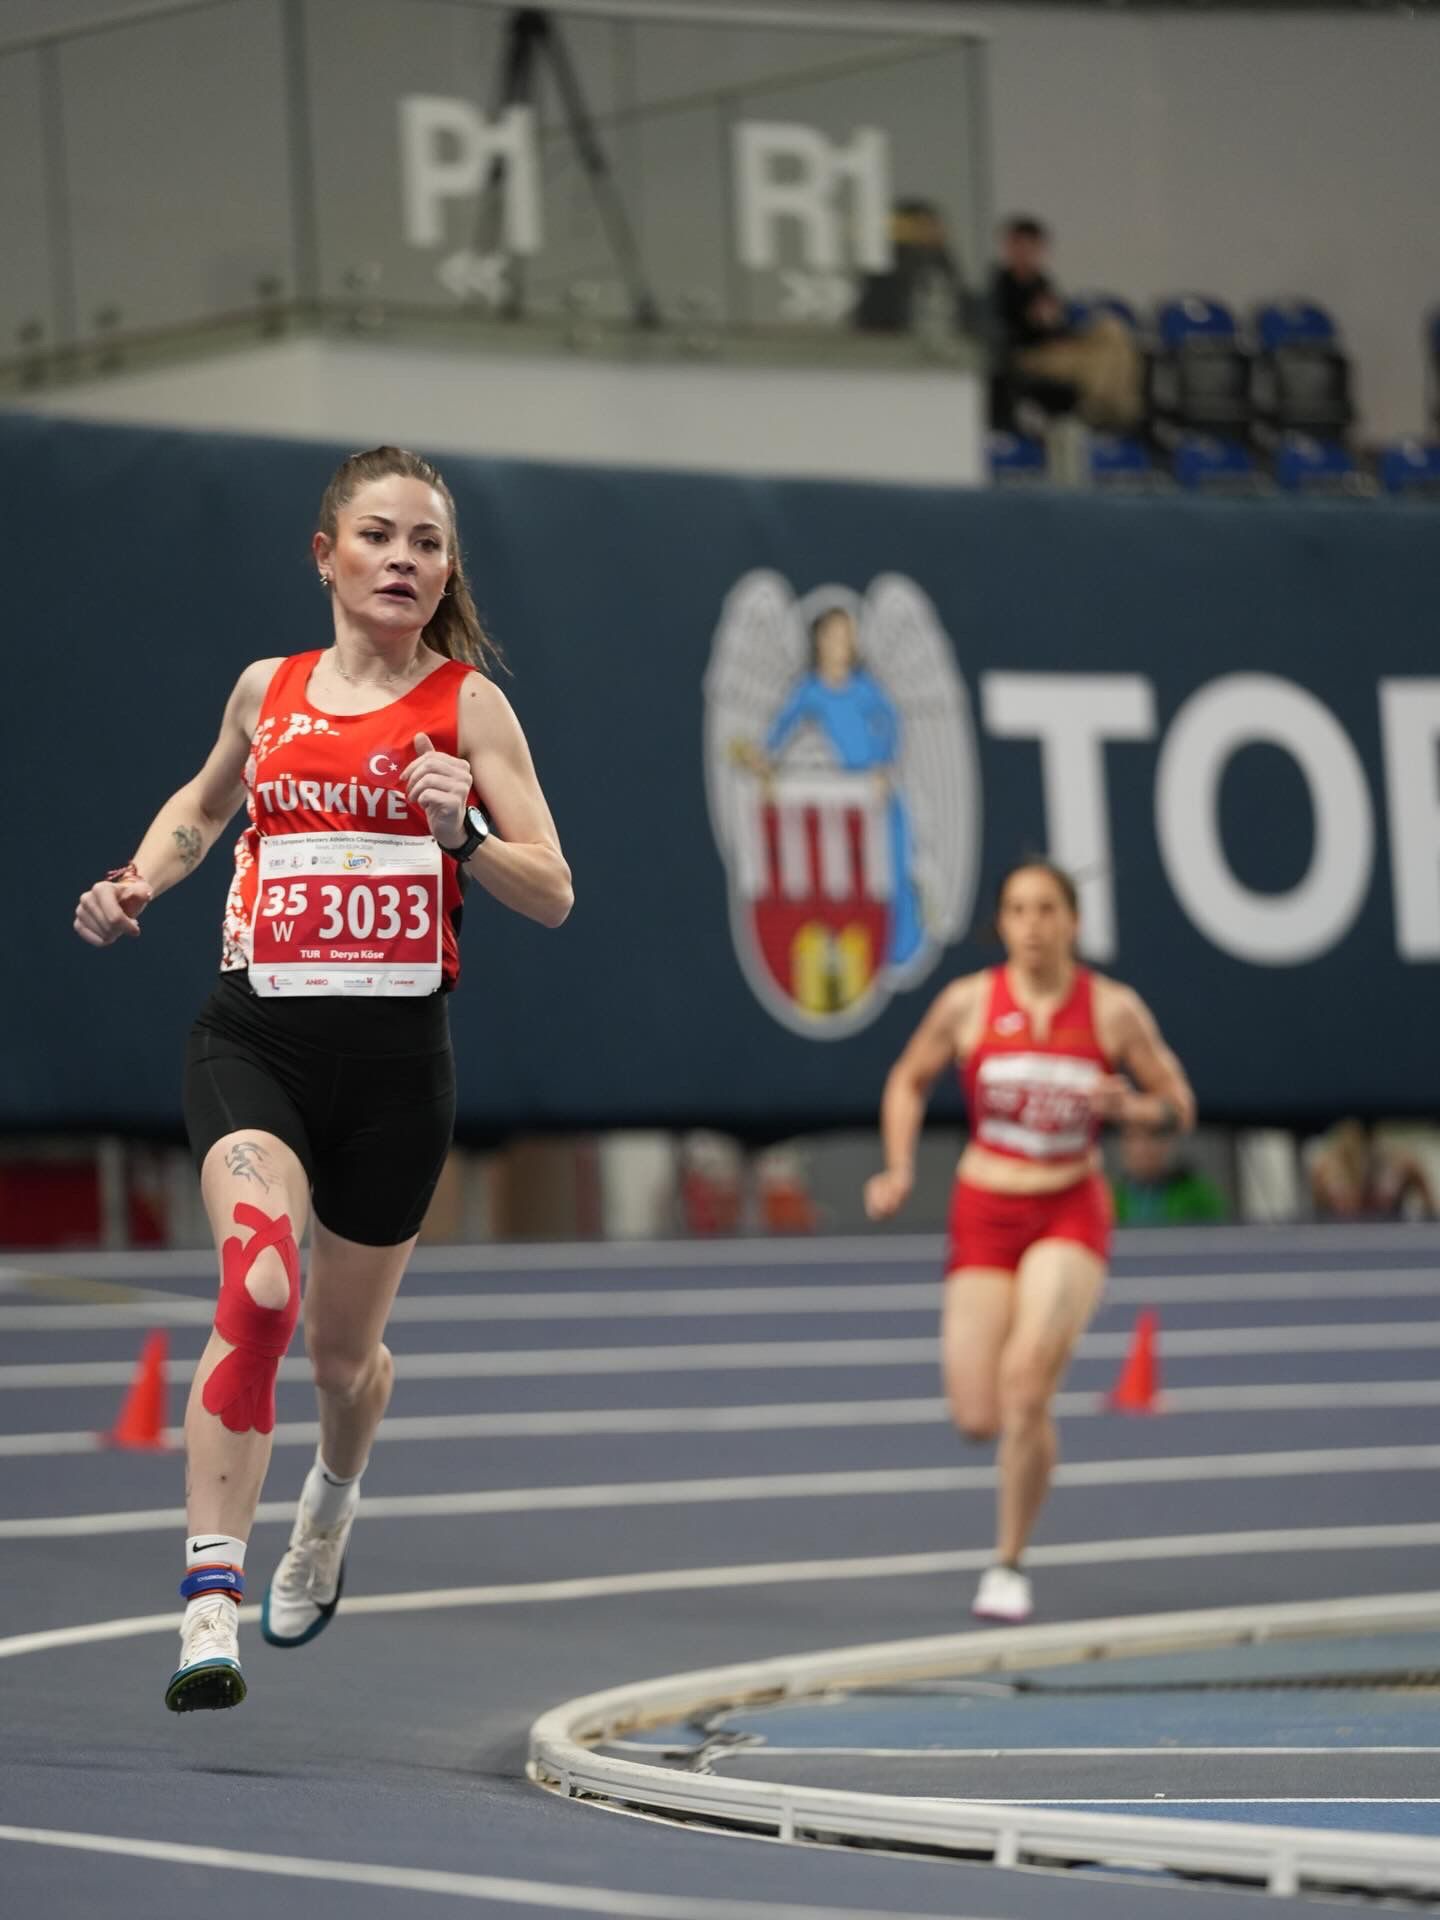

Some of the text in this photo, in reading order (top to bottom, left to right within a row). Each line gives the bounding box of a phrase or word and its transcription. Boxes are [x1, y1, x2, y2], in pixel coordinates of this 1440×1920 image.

[404, 95, 540, 254] P1
[732, 119, 892, 275] R1
[256, 774, 408, 820] TÜRKİYE
[329, 836, 355, 844] Athletics
[357, 837, 403, 848] Championships
[262, 883, 308, 917] 35
[319, 885, 430, 939] 3033
[272, 921, 295, 942] W
[301, 950, 384, 961] TUR Derya Köse
